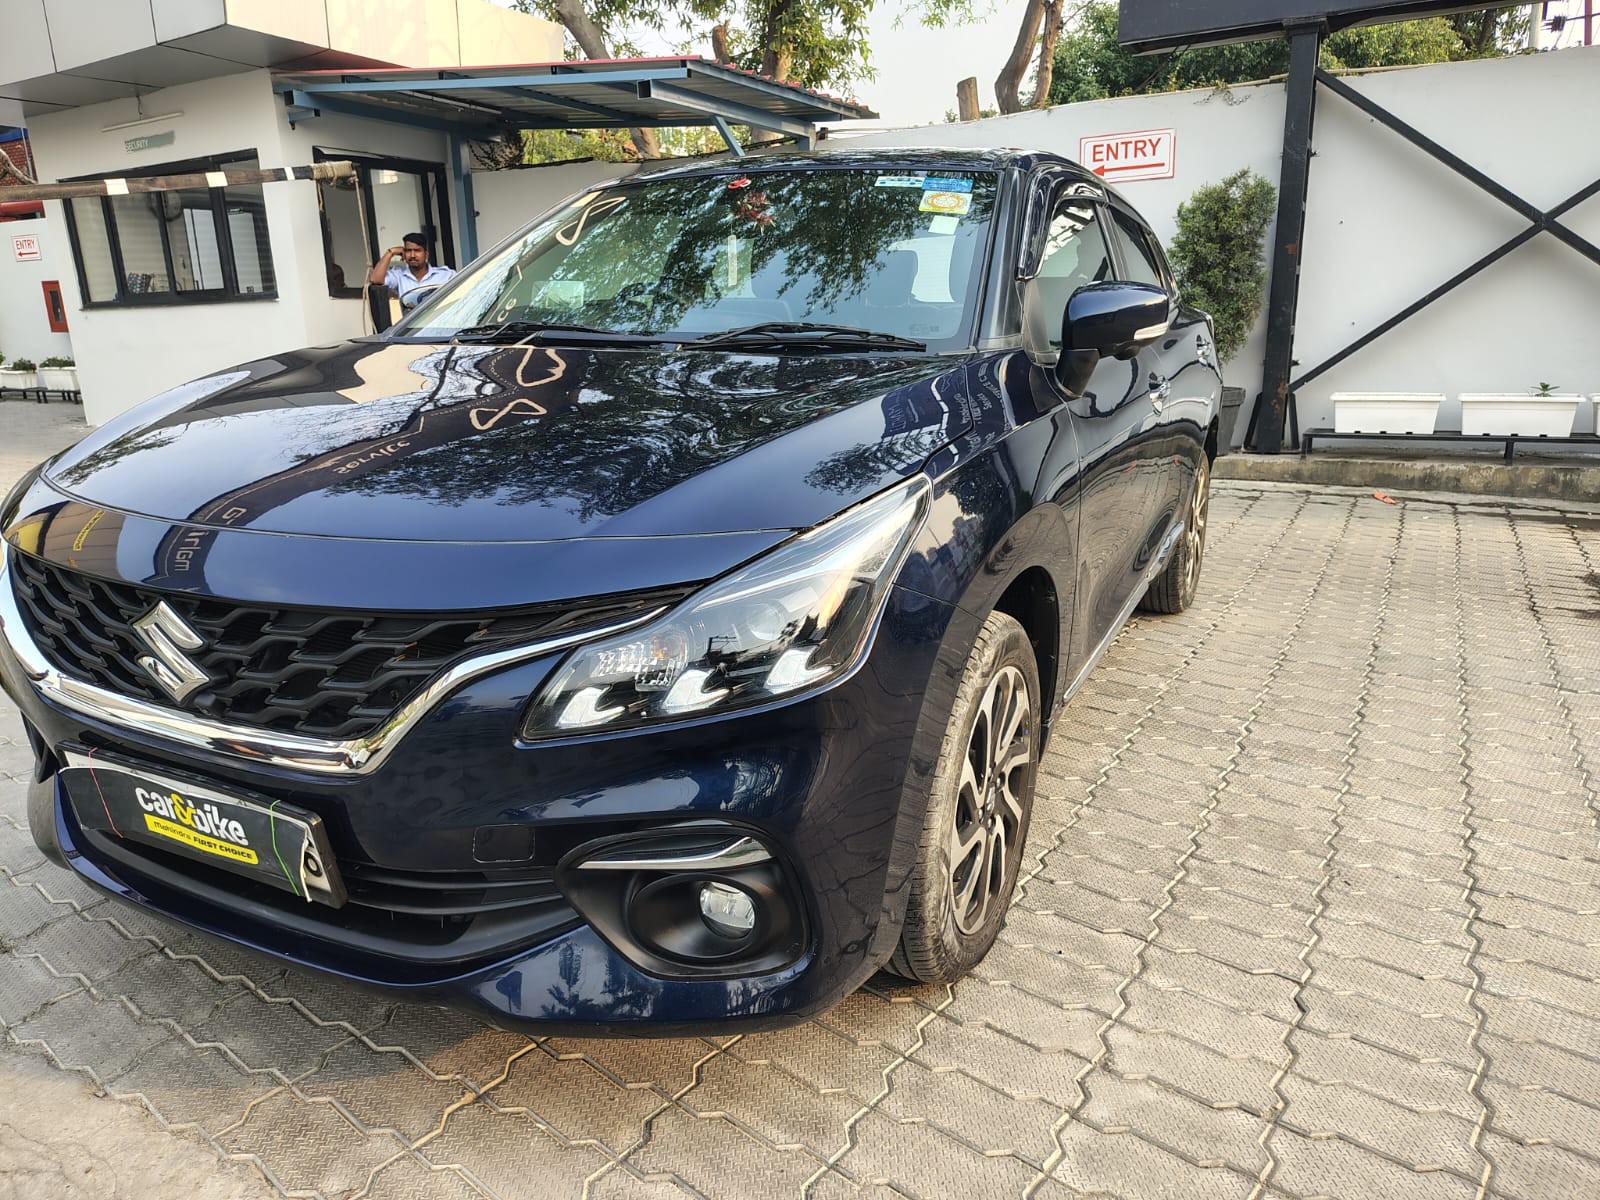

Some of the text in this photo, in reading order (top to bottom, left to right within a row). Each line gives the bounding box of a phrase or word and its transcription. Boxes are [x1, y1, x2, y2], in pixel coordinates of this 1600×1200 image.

[1092, 137, 1162, 163] ENTRY
[15, 239, 36, 250] ENTRY
[193, 835, 218, 850] FIRST
[219, 844, 253, 860] CHOICE
